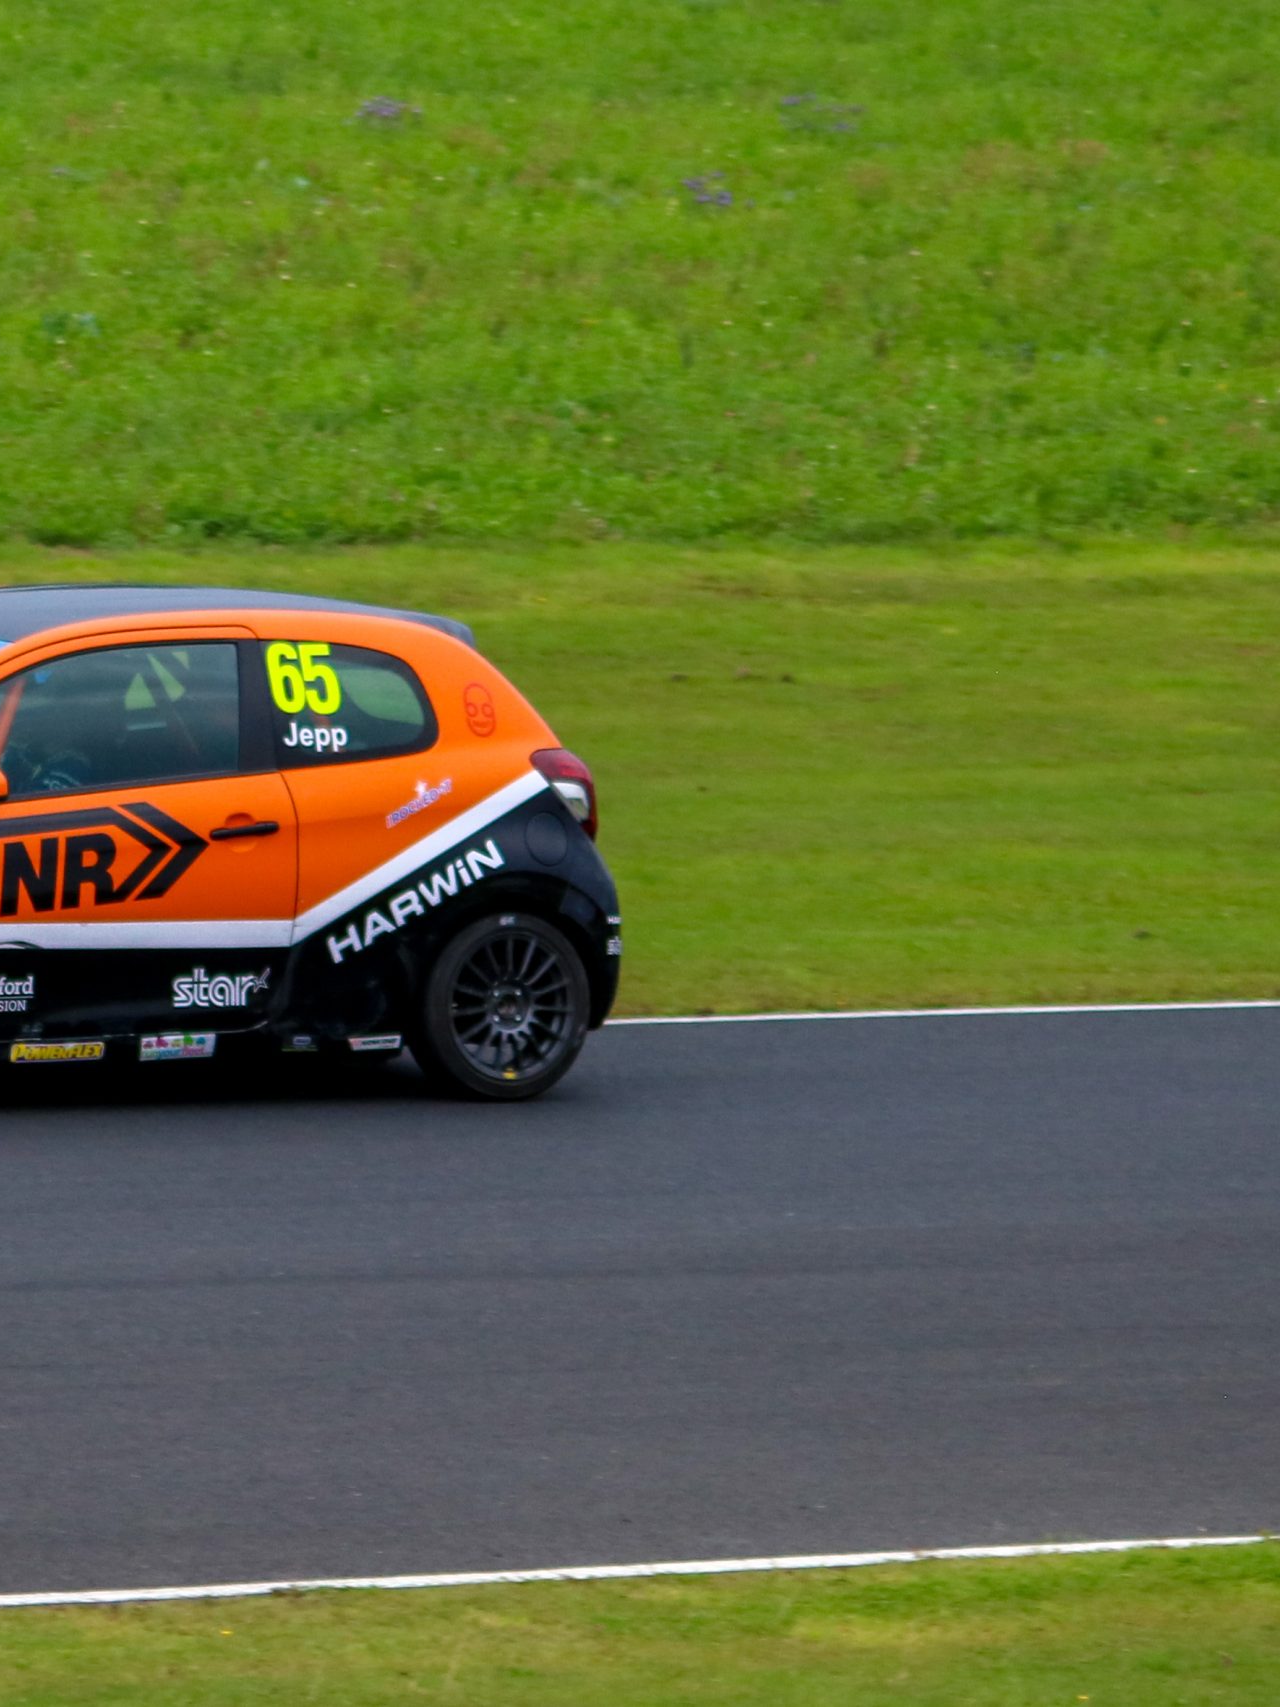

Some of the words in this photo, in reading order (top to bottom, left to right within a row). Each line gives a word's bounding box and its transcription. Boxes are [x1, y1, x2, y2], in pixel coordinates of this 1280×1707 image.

[266, 642, 341, 715] 65
[283, 722, 347, 752] Jepp
[172, 967, 257, 1008] star
